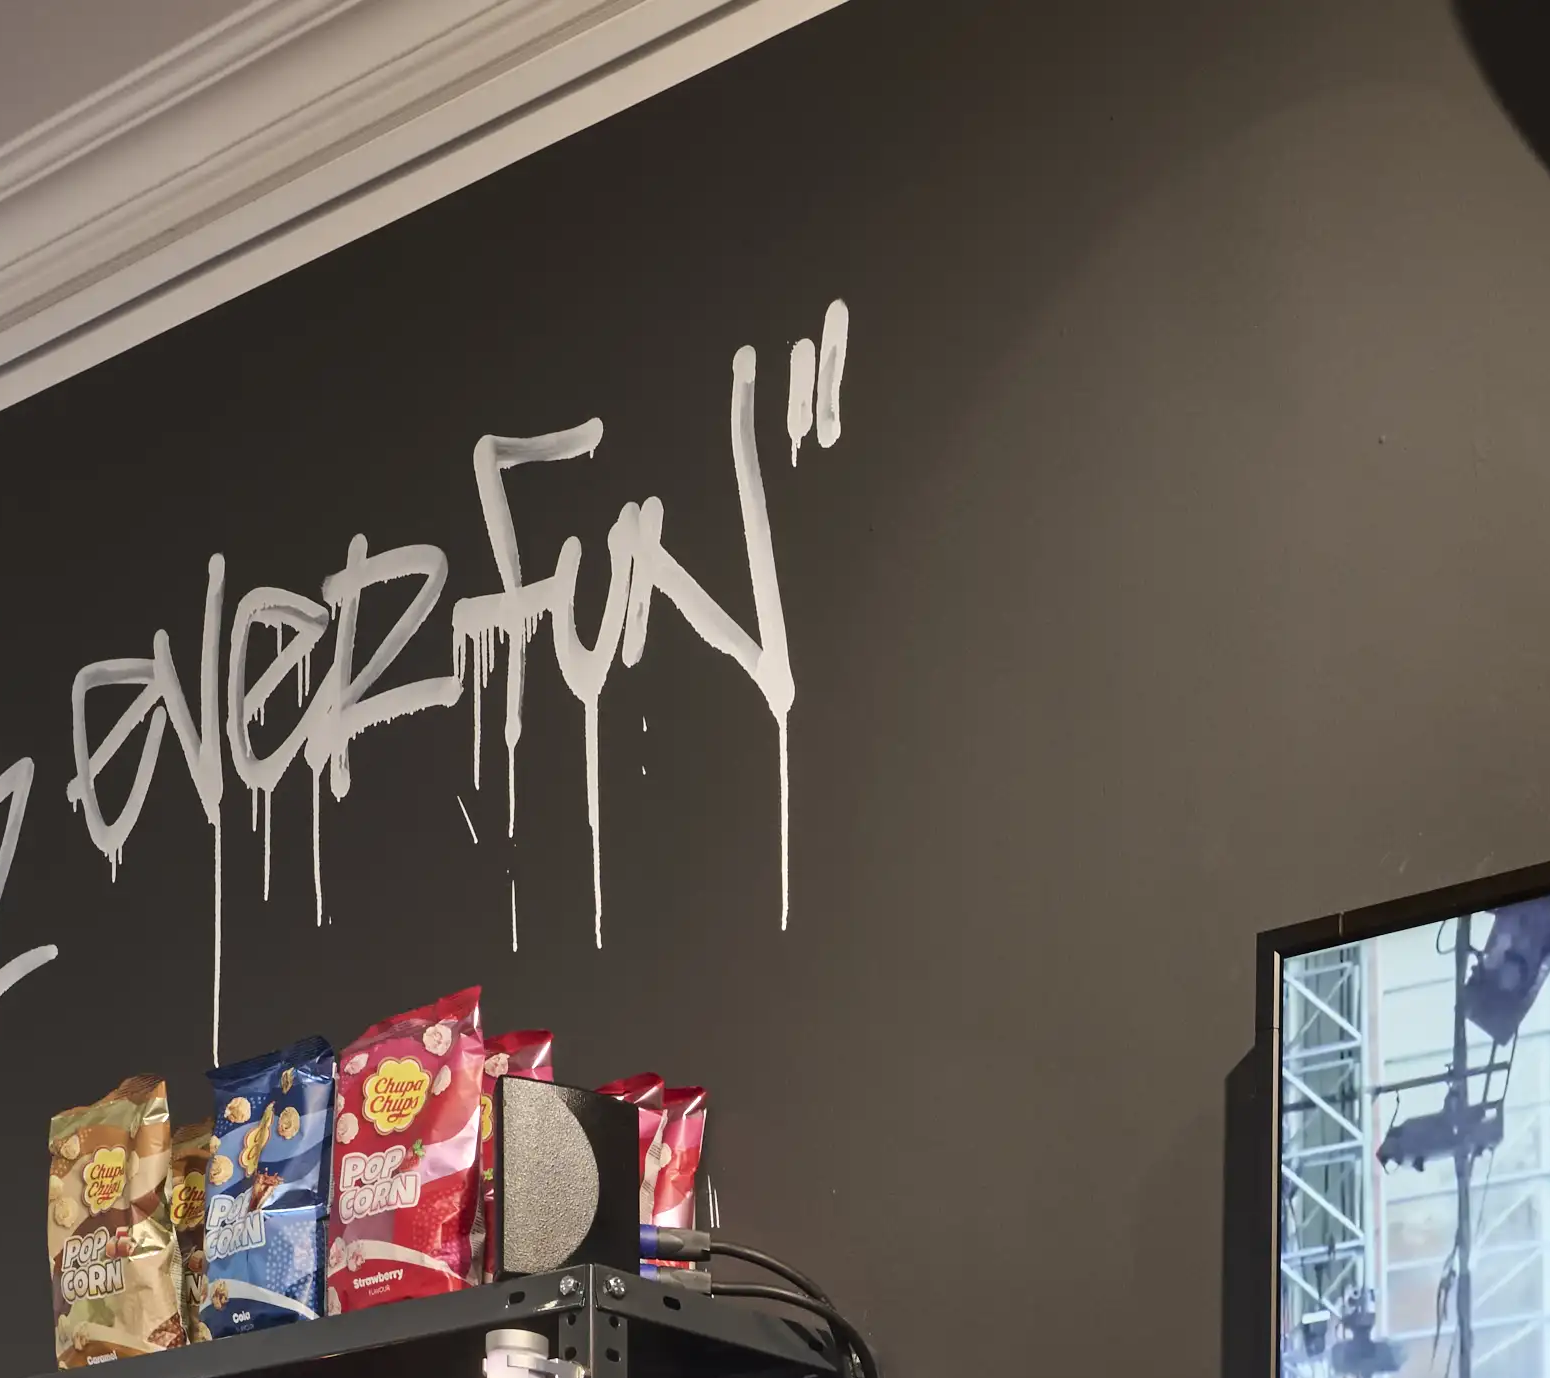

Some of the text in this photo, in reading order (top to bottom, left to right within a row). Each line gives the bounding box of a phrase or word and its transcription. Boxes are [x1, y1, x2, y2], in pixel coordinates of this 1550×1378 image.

[370, 1094, 426, 1123] Chups
[374, 1077, 431, 1101] Chupa
[341, 1146, 404, 1192] POP
[339, 1170, 421, 1224] CORN
[62, 1227, 107, 1269] POP
[61, 1254, 124, 1302] CORN
[352, 1268, 404, 1290] Strawberry
